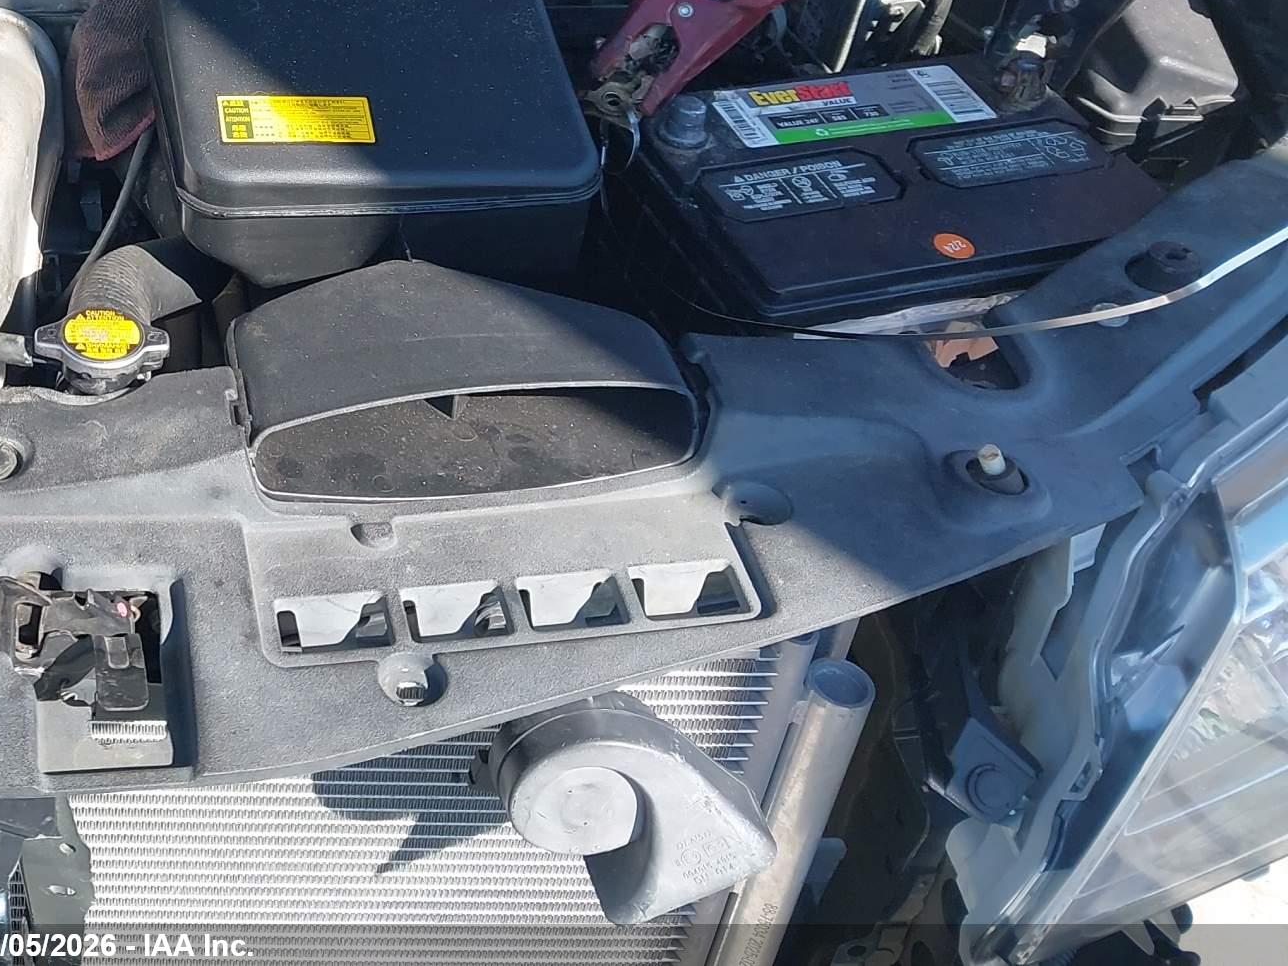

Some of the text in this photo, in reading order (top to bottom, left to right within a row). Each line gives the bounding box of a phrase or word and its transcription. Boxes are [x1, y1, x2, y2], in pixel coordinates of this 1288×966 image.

[749, 81, 853, 108] EverStart
[745, 167, 791, 183] DANGER
[800, 158, 843, 174] POISON
